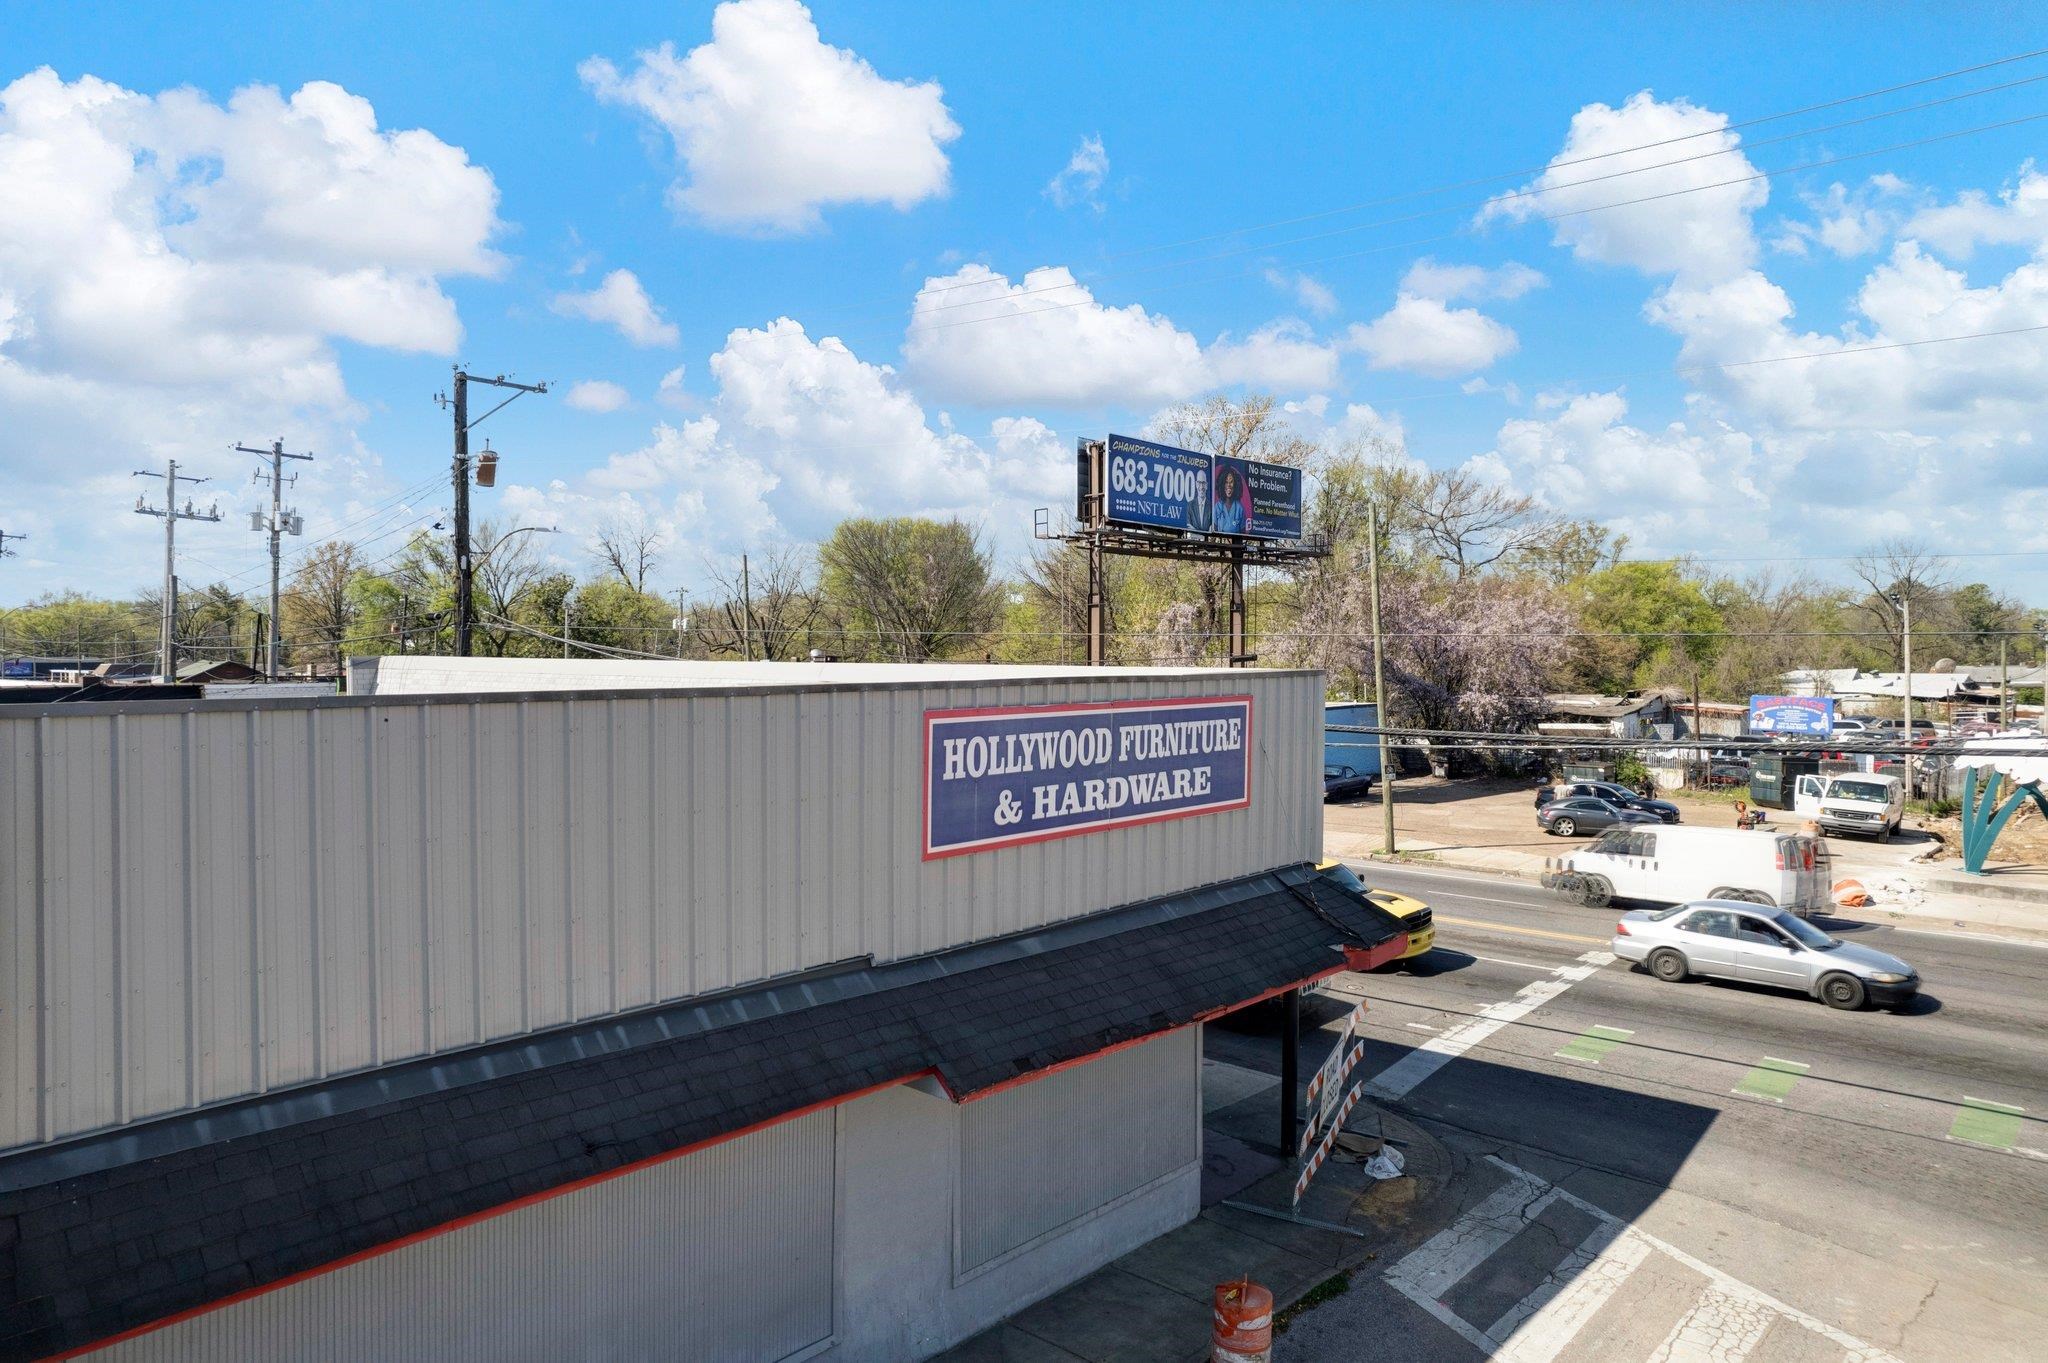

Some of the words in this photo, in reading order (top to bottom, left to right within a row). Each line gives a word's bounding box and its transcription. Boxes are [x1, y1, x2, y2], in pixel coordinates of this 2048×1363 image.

[1112, 440, 1160, 459] CHAMPIONS
[1177, 454, 1208, 468] INJURED
[1112, 455, 1196, 502] 683-7000
[1248, 463, 1259, 475] No
[1260, 465, 1292, 480] Insurance?
[1248, 476, 1259, 488] No
[1260, 479, 1288, 493] Problem.
[1138, 499, 1159, 516] NST
[1160, 504, 1182, 519] LAW
[1253, 497, 1271, 506] Planned
[1271, 499, 1296, 510] Parenthood
[943, 727, 1113, 781] HOLLYWOOD
[1118, 717, 1242, 762] FURNITURE
[994, 789, 1023, 826] &
[1031, 766, 1212, 820] HARDWARE
